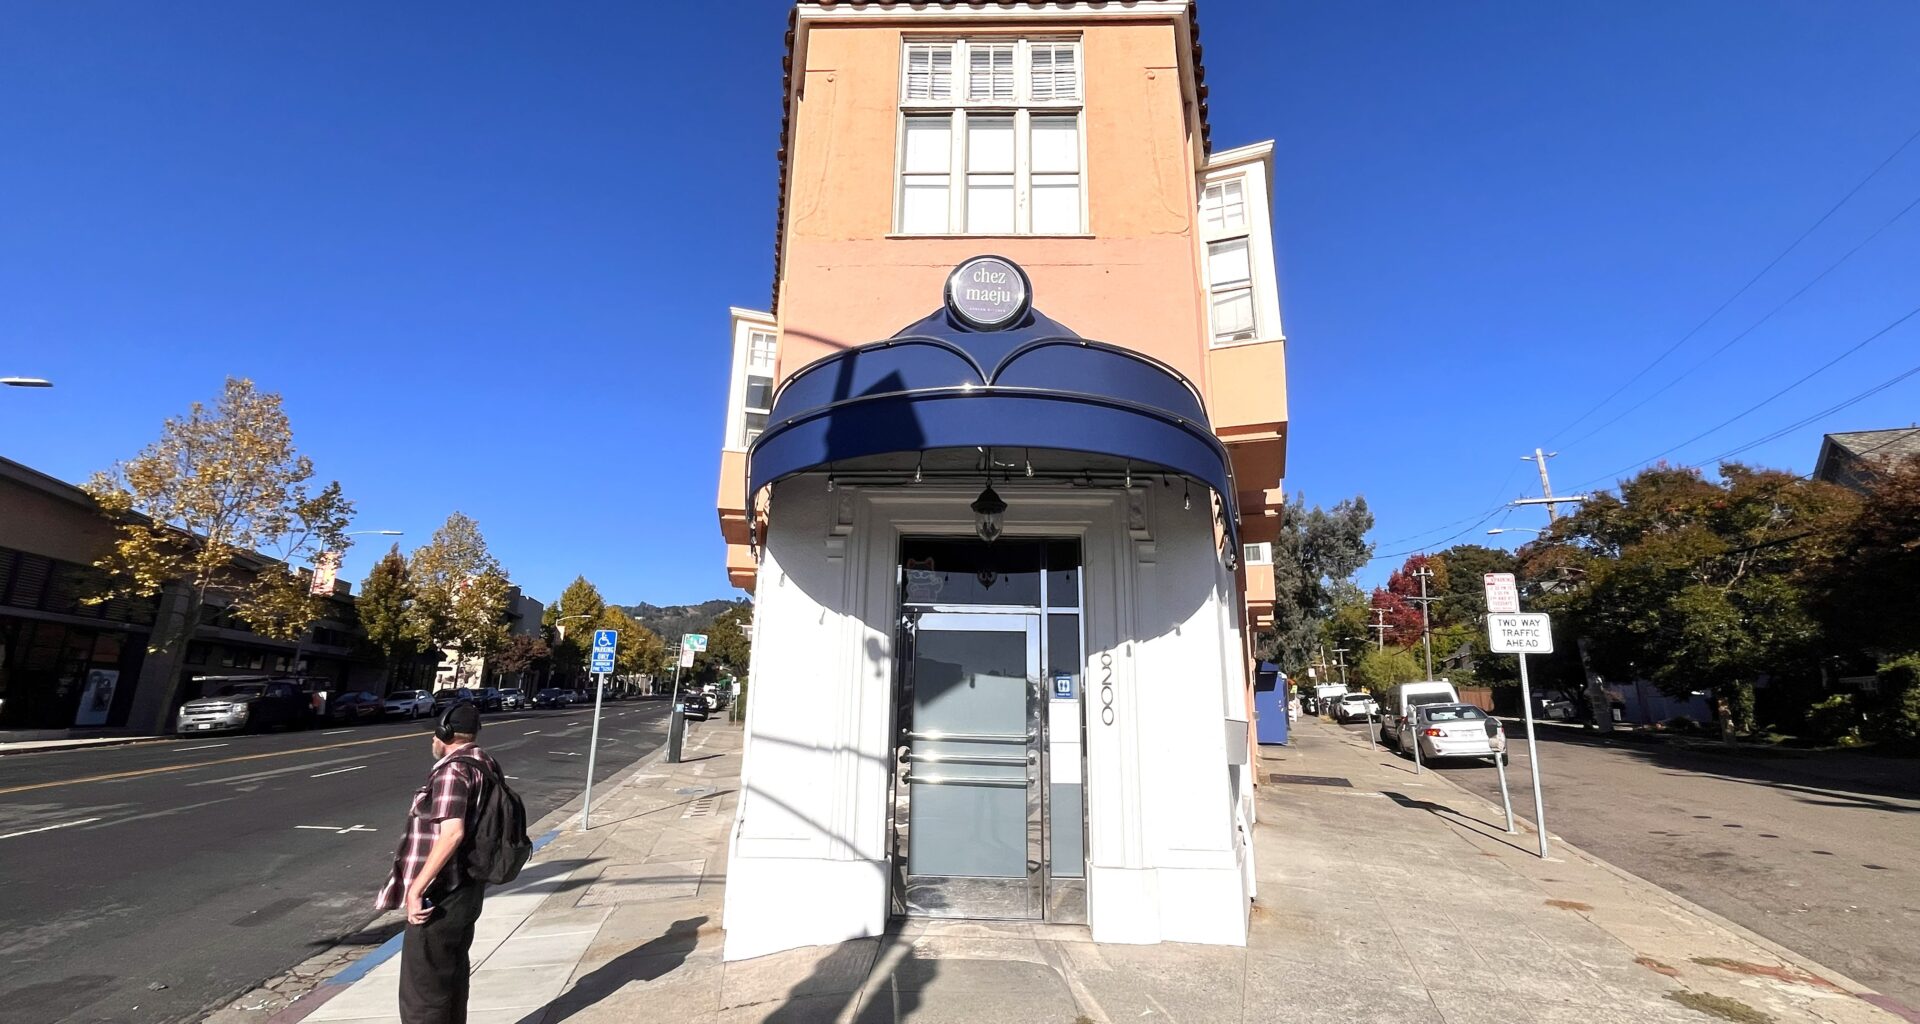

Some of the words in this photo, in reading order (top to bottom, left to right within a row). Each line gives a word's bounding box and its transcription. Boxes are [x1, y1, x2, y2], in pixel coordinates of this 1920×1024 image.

[973, 268, 1006, 284] chez
[966, 287, 1011, 306] maeju
[1497, 619, 1517, 627] TWO
[1521, 619, 1541, 627] WAY
[1502, 629, 1540, 637] TRAFFIC
[1506, 639, 1539, 647] AHEAD
